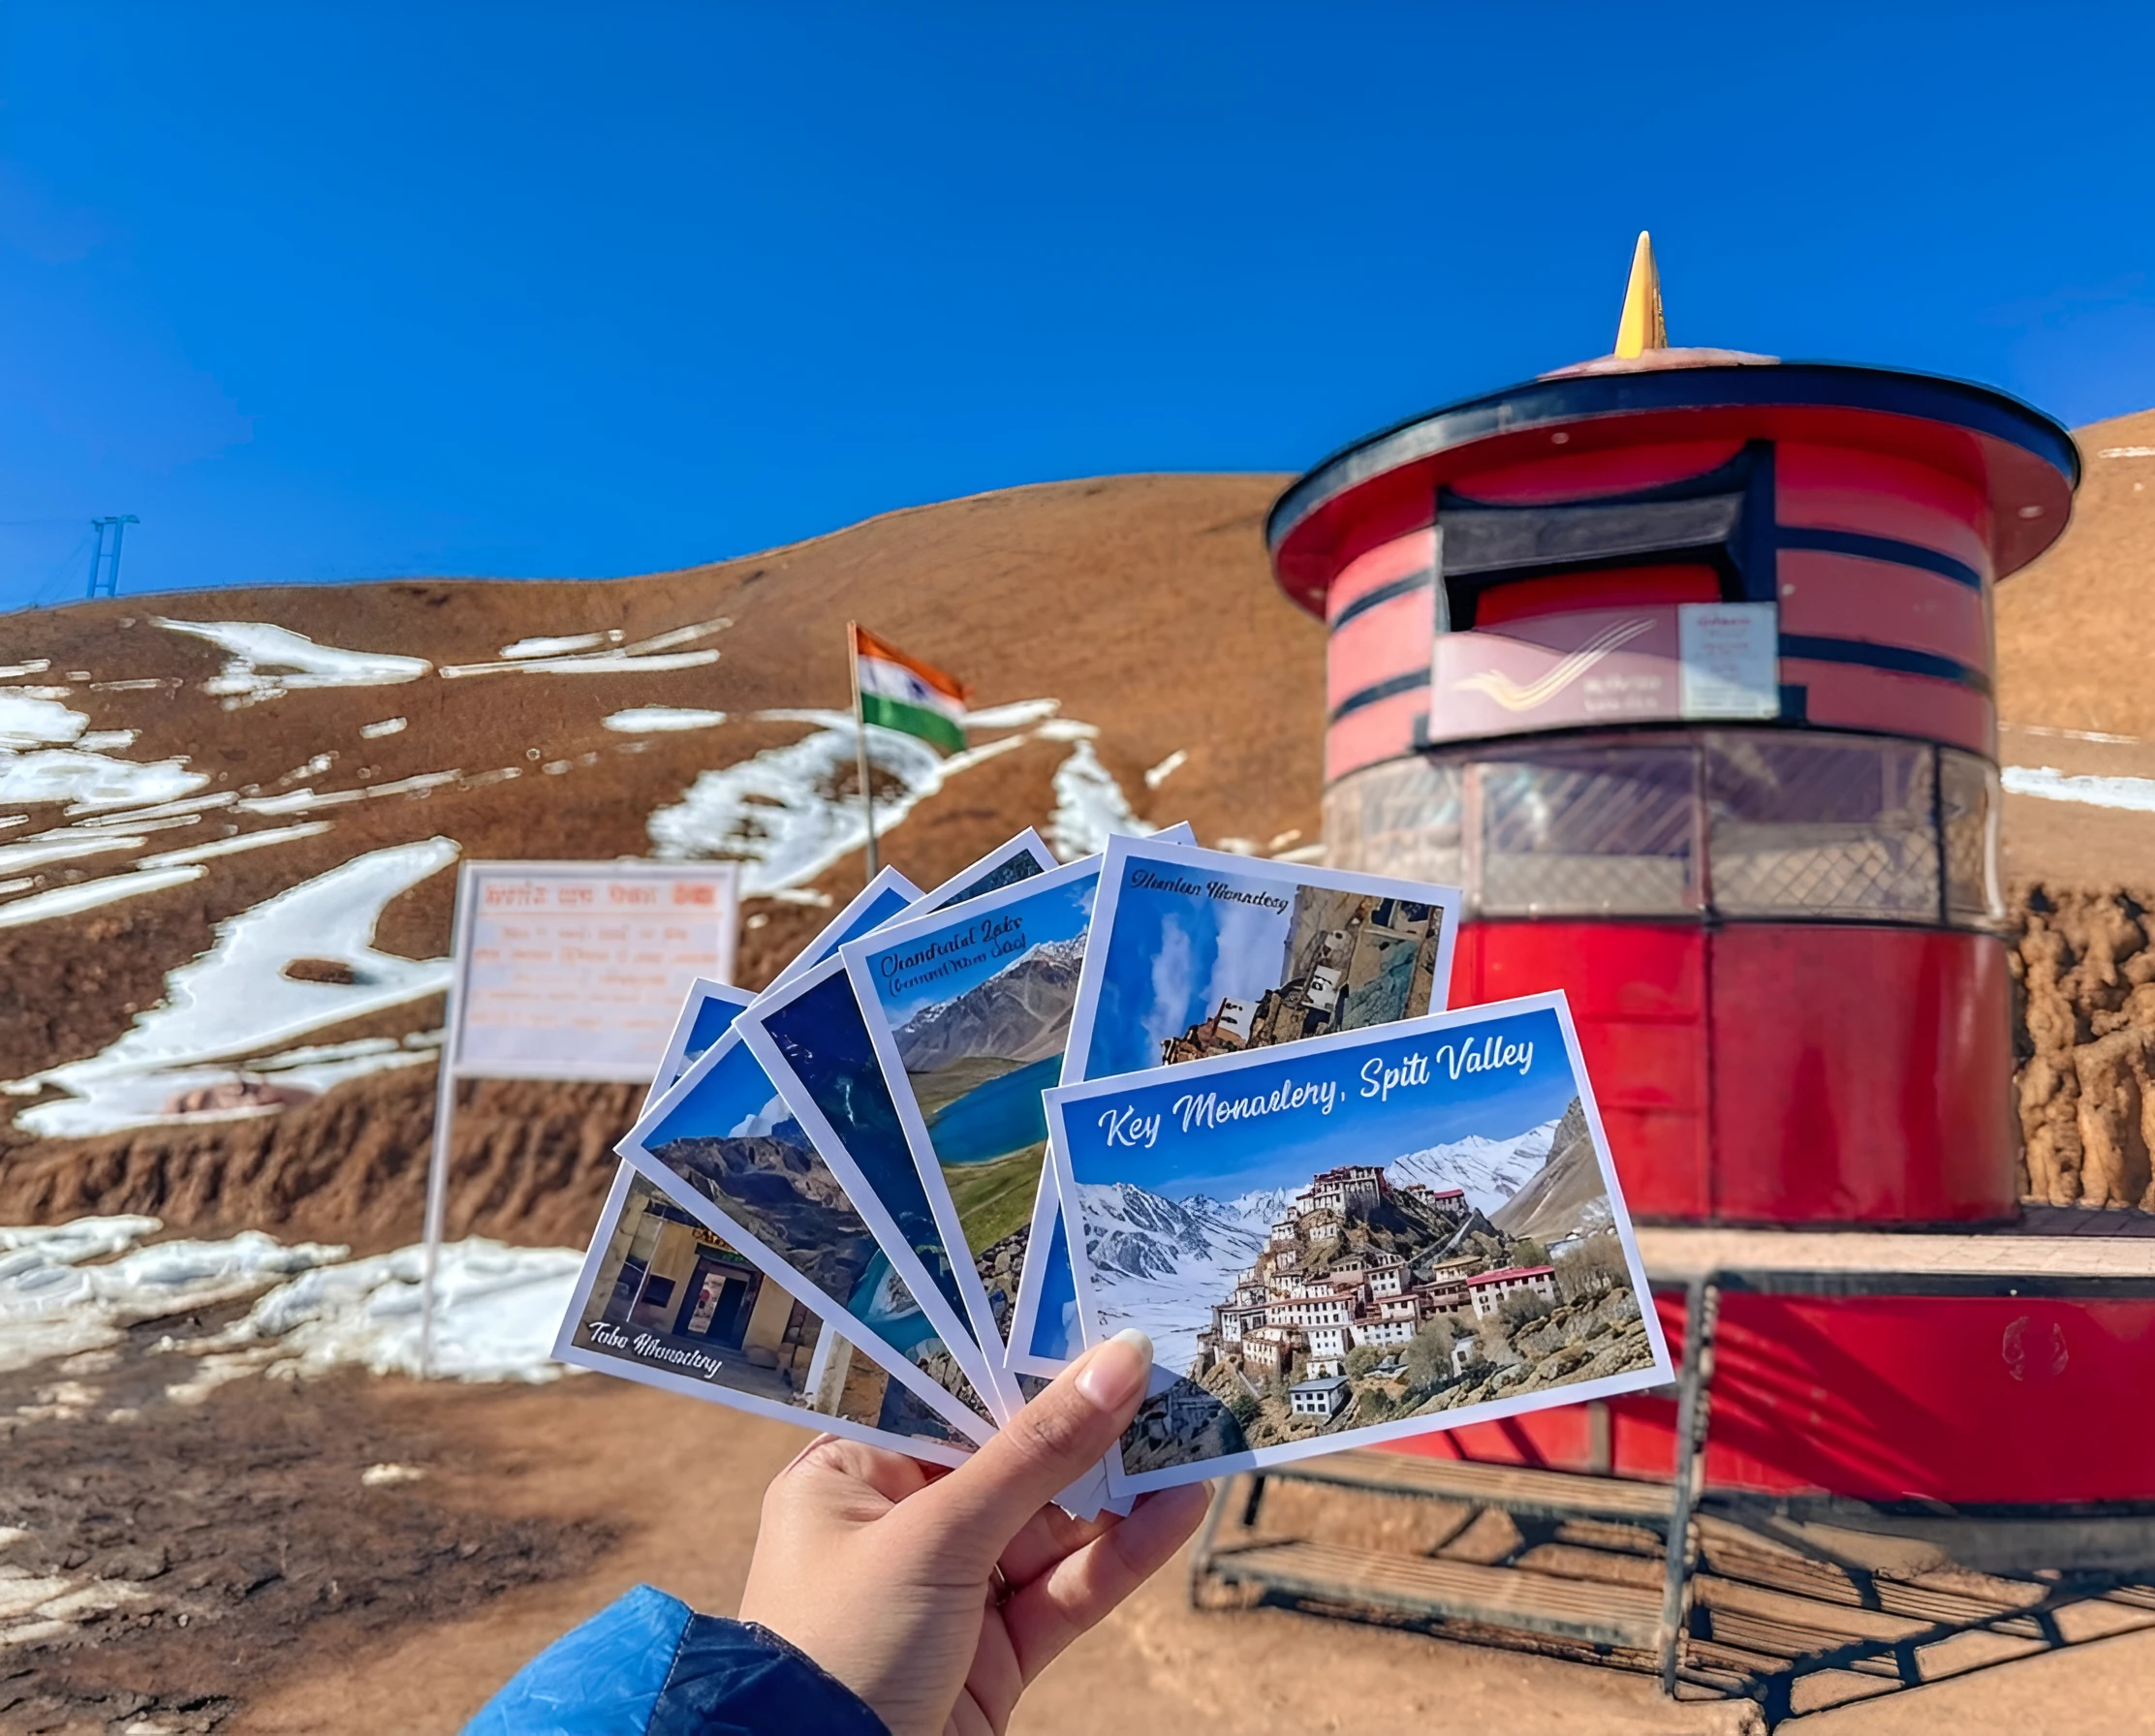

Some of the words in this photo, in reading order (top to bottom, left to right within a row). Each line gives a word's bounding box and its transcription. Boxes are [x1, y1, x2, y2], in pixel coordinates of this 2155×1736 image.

[1098, 1104, 1161, 1149] Key
[1172, 1079, 1346, 1132] Monastery,
[1360, 1052, 1430, 1102] Spiti
[1436, 1036, 1533, 1080] Valley
